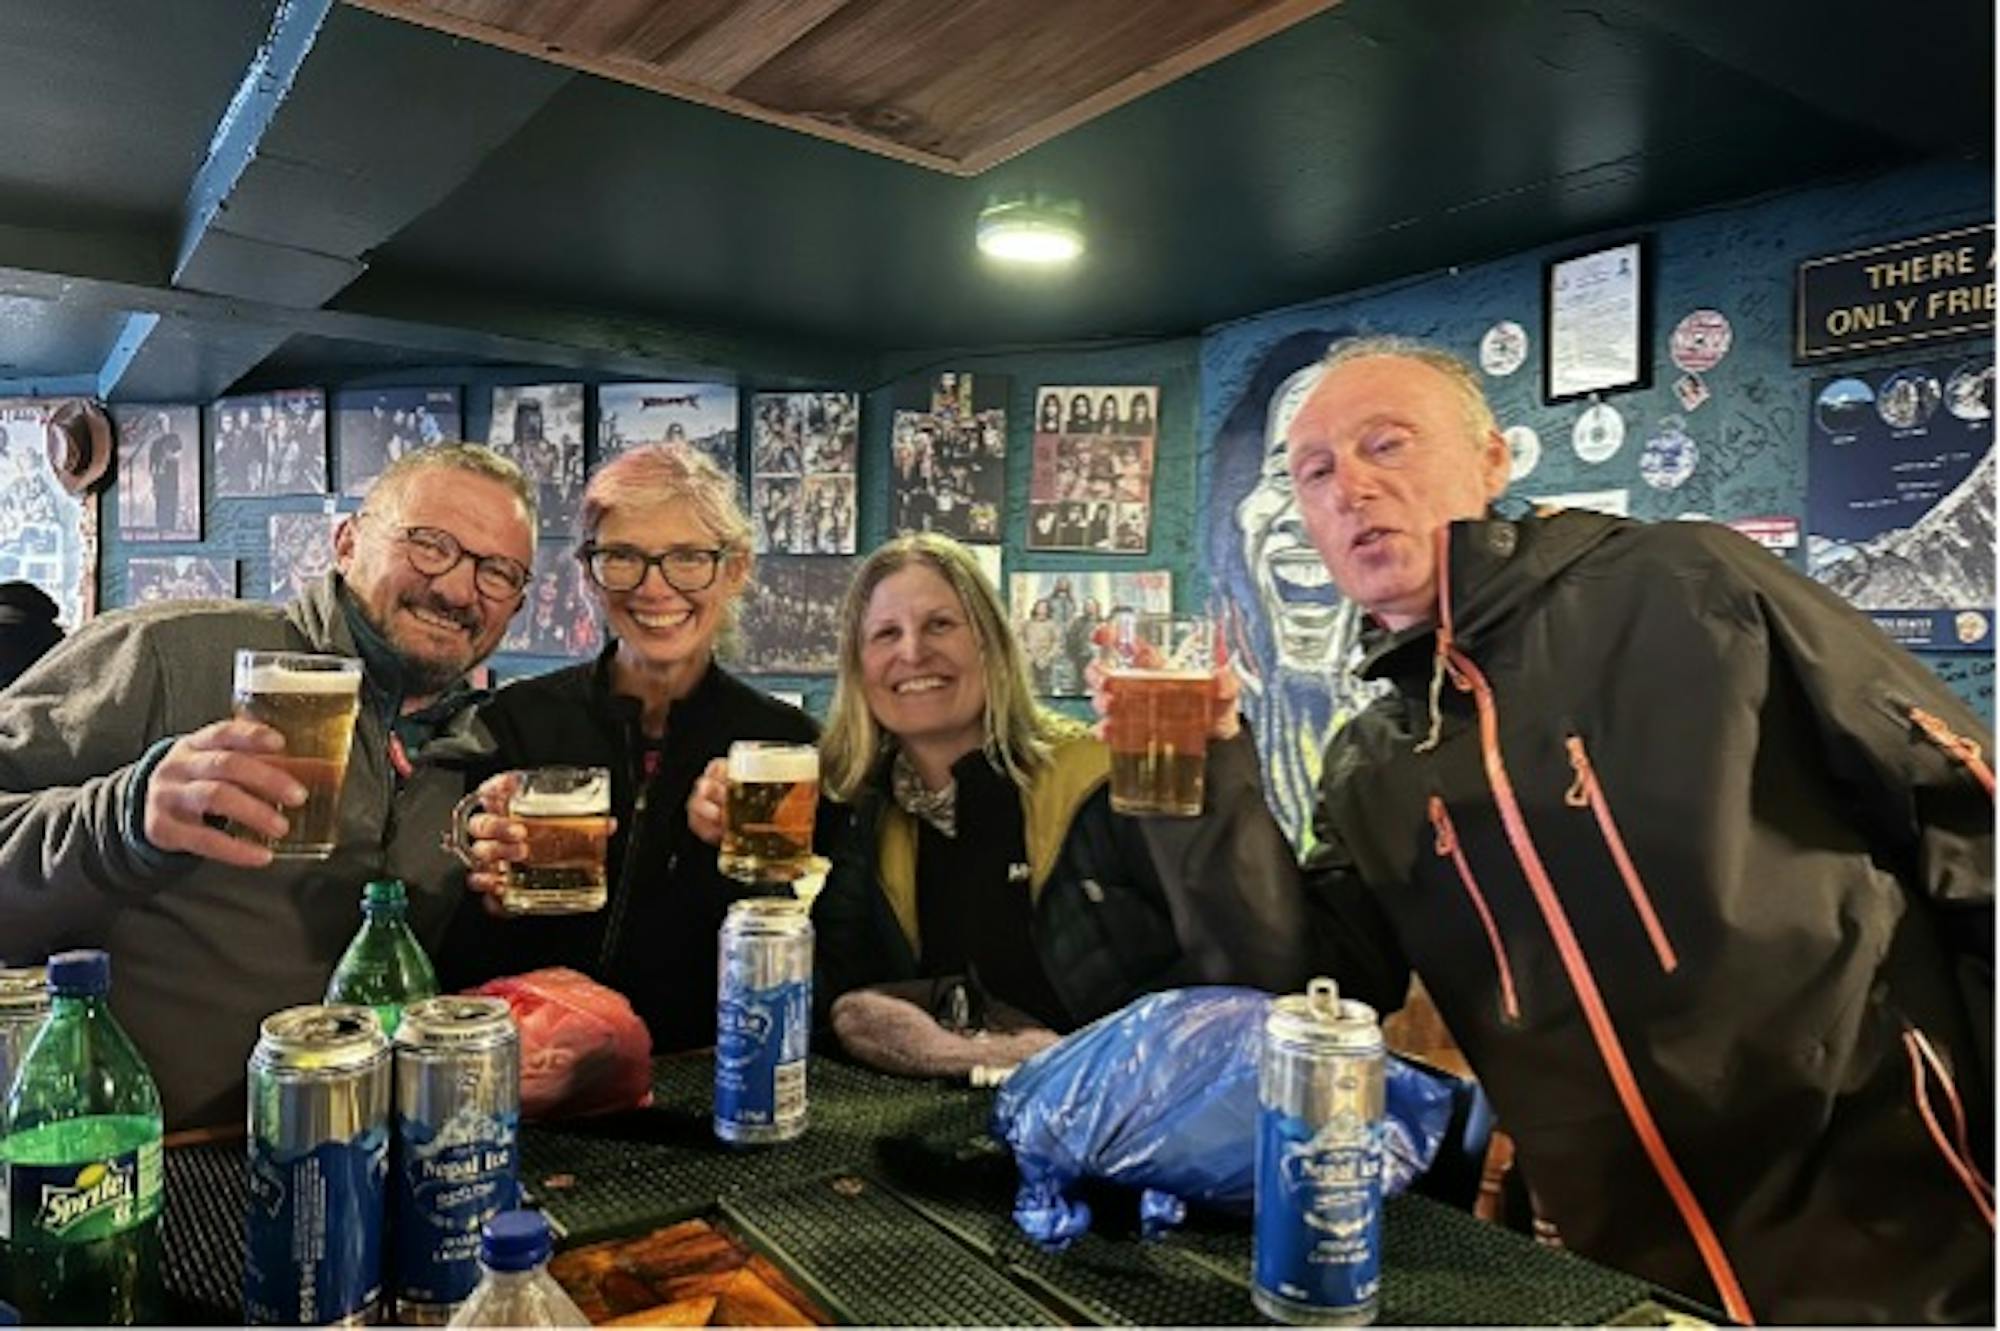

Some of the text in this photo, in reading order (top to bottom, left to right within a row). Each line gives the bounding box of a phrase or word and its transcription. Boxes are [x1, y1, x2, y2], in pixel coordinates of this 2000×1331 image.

[1863, 247, 1976, 290] THERE
[1826, 296, 1918, 337] ONLY
[422, 1153, 479, 1184] Nepal
[44, 1168, 126, 1225] Sprite
